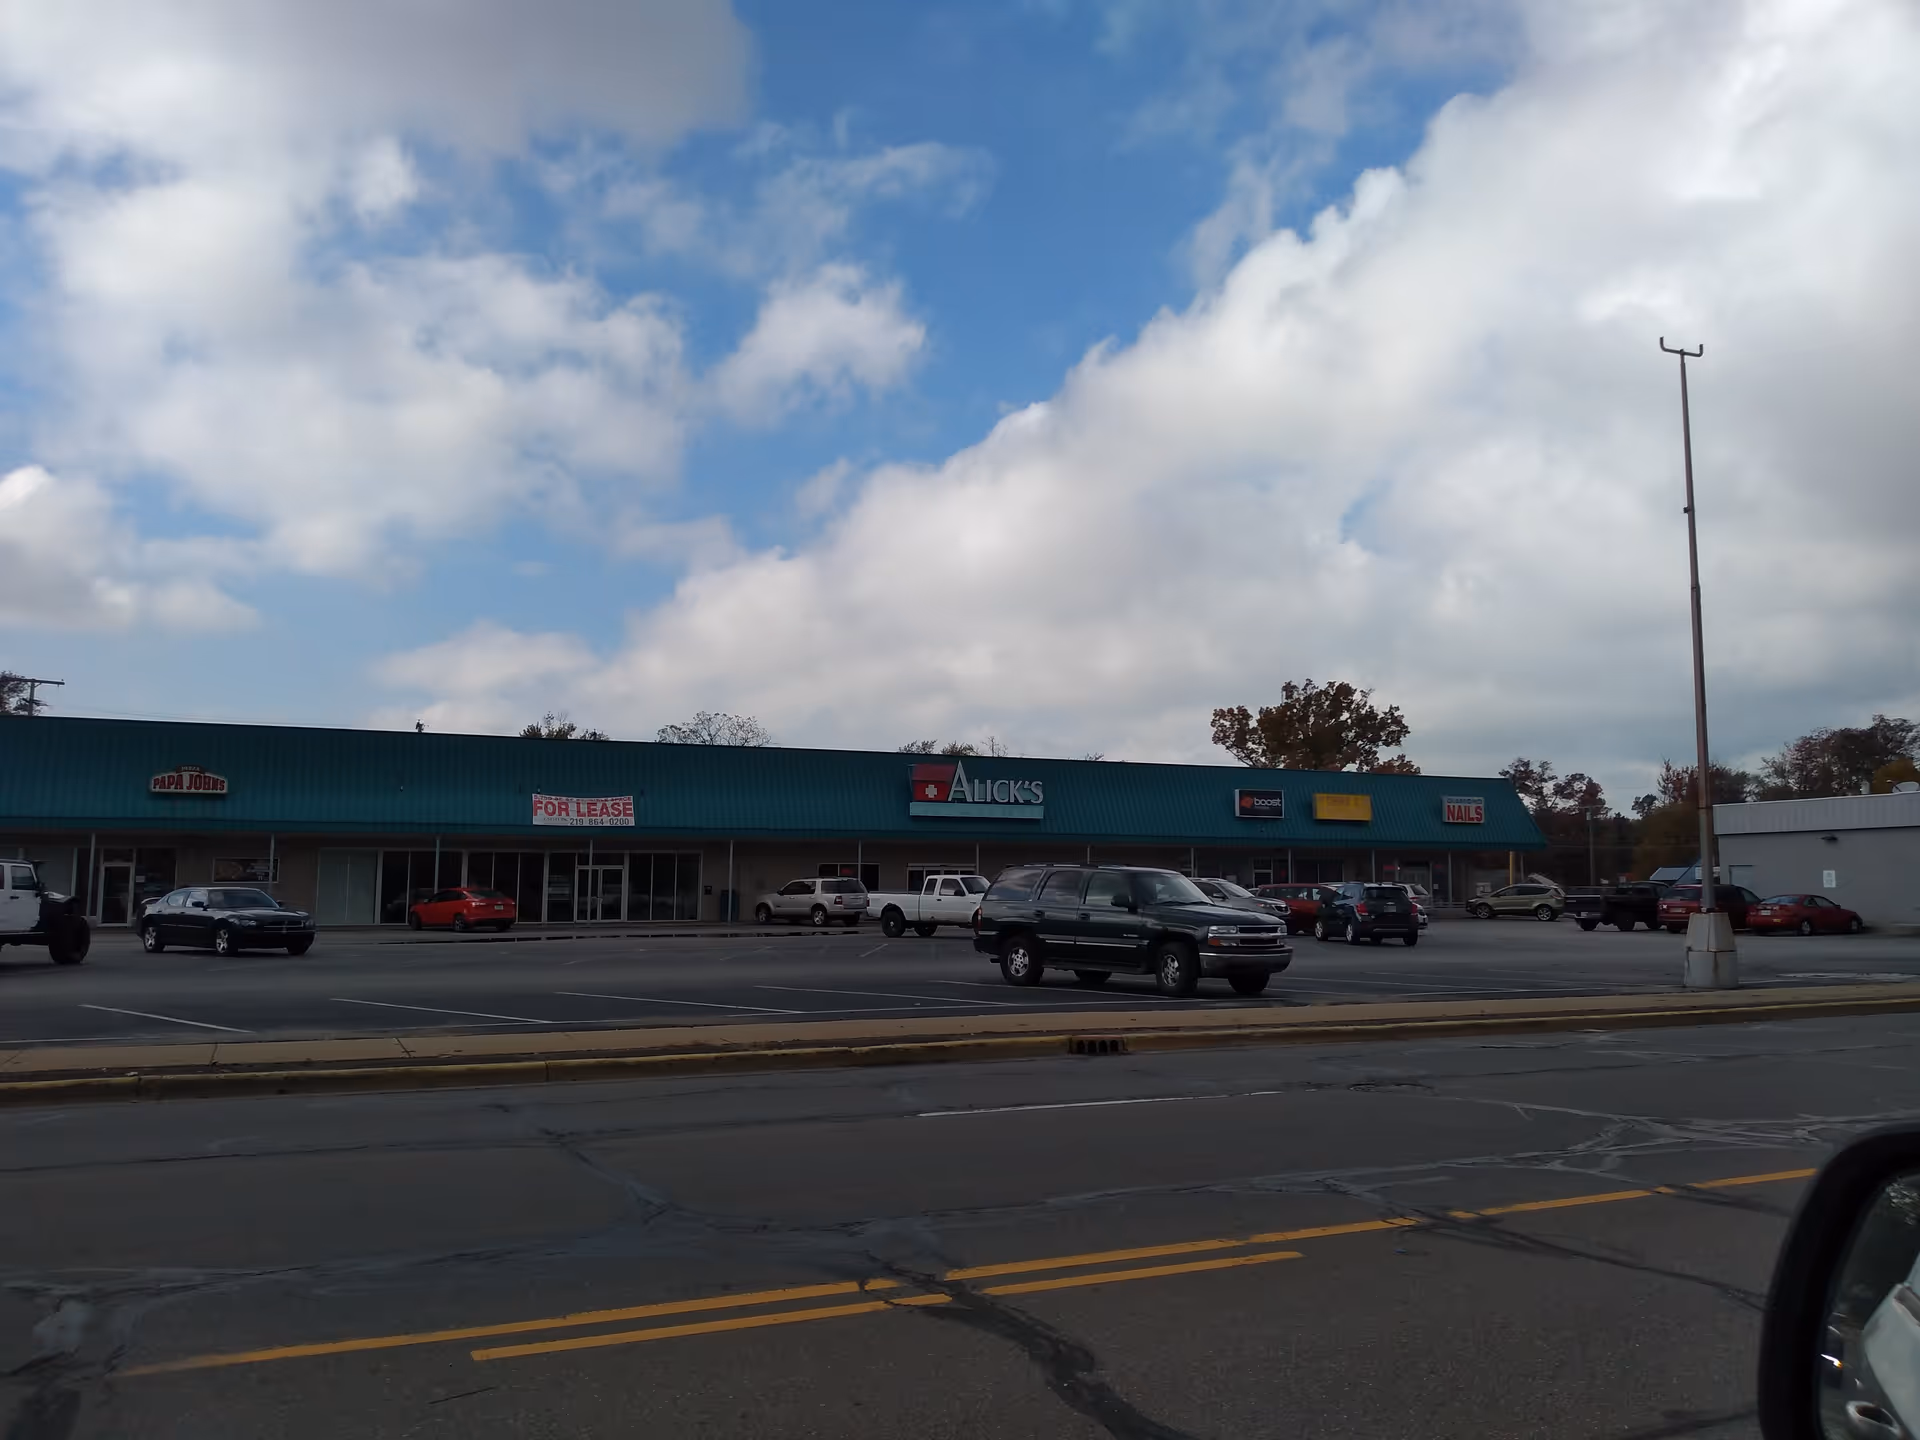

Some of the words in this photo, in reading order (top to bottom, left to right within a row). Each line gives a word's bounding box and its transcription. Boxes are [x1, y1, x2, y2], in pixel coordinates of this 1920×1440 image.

[153, 774, 184, 790] PAPA
[948, 760, 1043, 804] ALICK'S
[533, 800, 570, 817] FOR
[576, 801, 634, 818] LEASE
[1254, 797, 1282, 807] boost
[569, 817, 584, 826] 219
[588, 817, 605, 826] 864
[609, 817, 630, 826] 0200
[1447, 805, 1483, 822] NAILS
